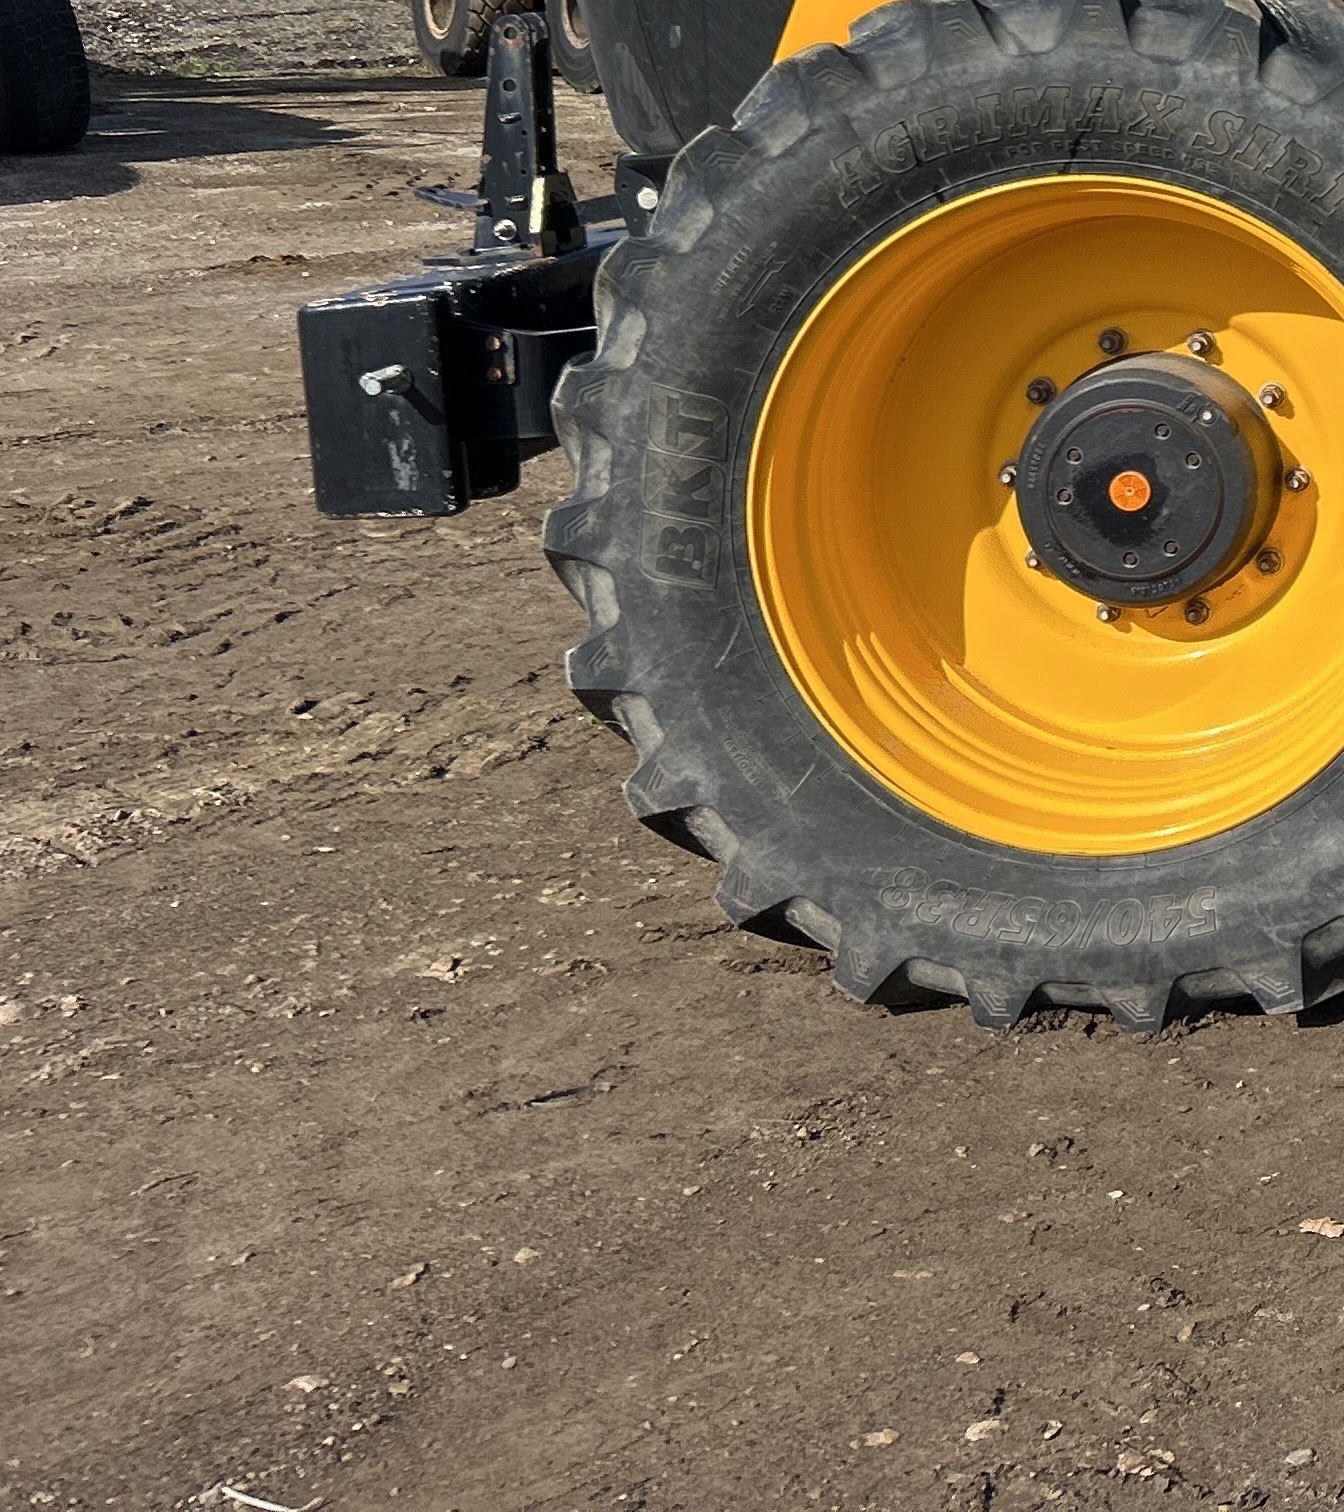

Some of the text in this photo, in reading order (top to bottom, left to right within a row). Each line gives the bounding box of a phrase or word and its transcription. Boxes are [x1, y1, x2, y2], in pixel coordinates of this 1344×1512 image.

[831, 86, 1185, 208] AGRIMAX
[648, 389, 721, 583] BKT
[880, 866, 1218, 949] 540/65R38
